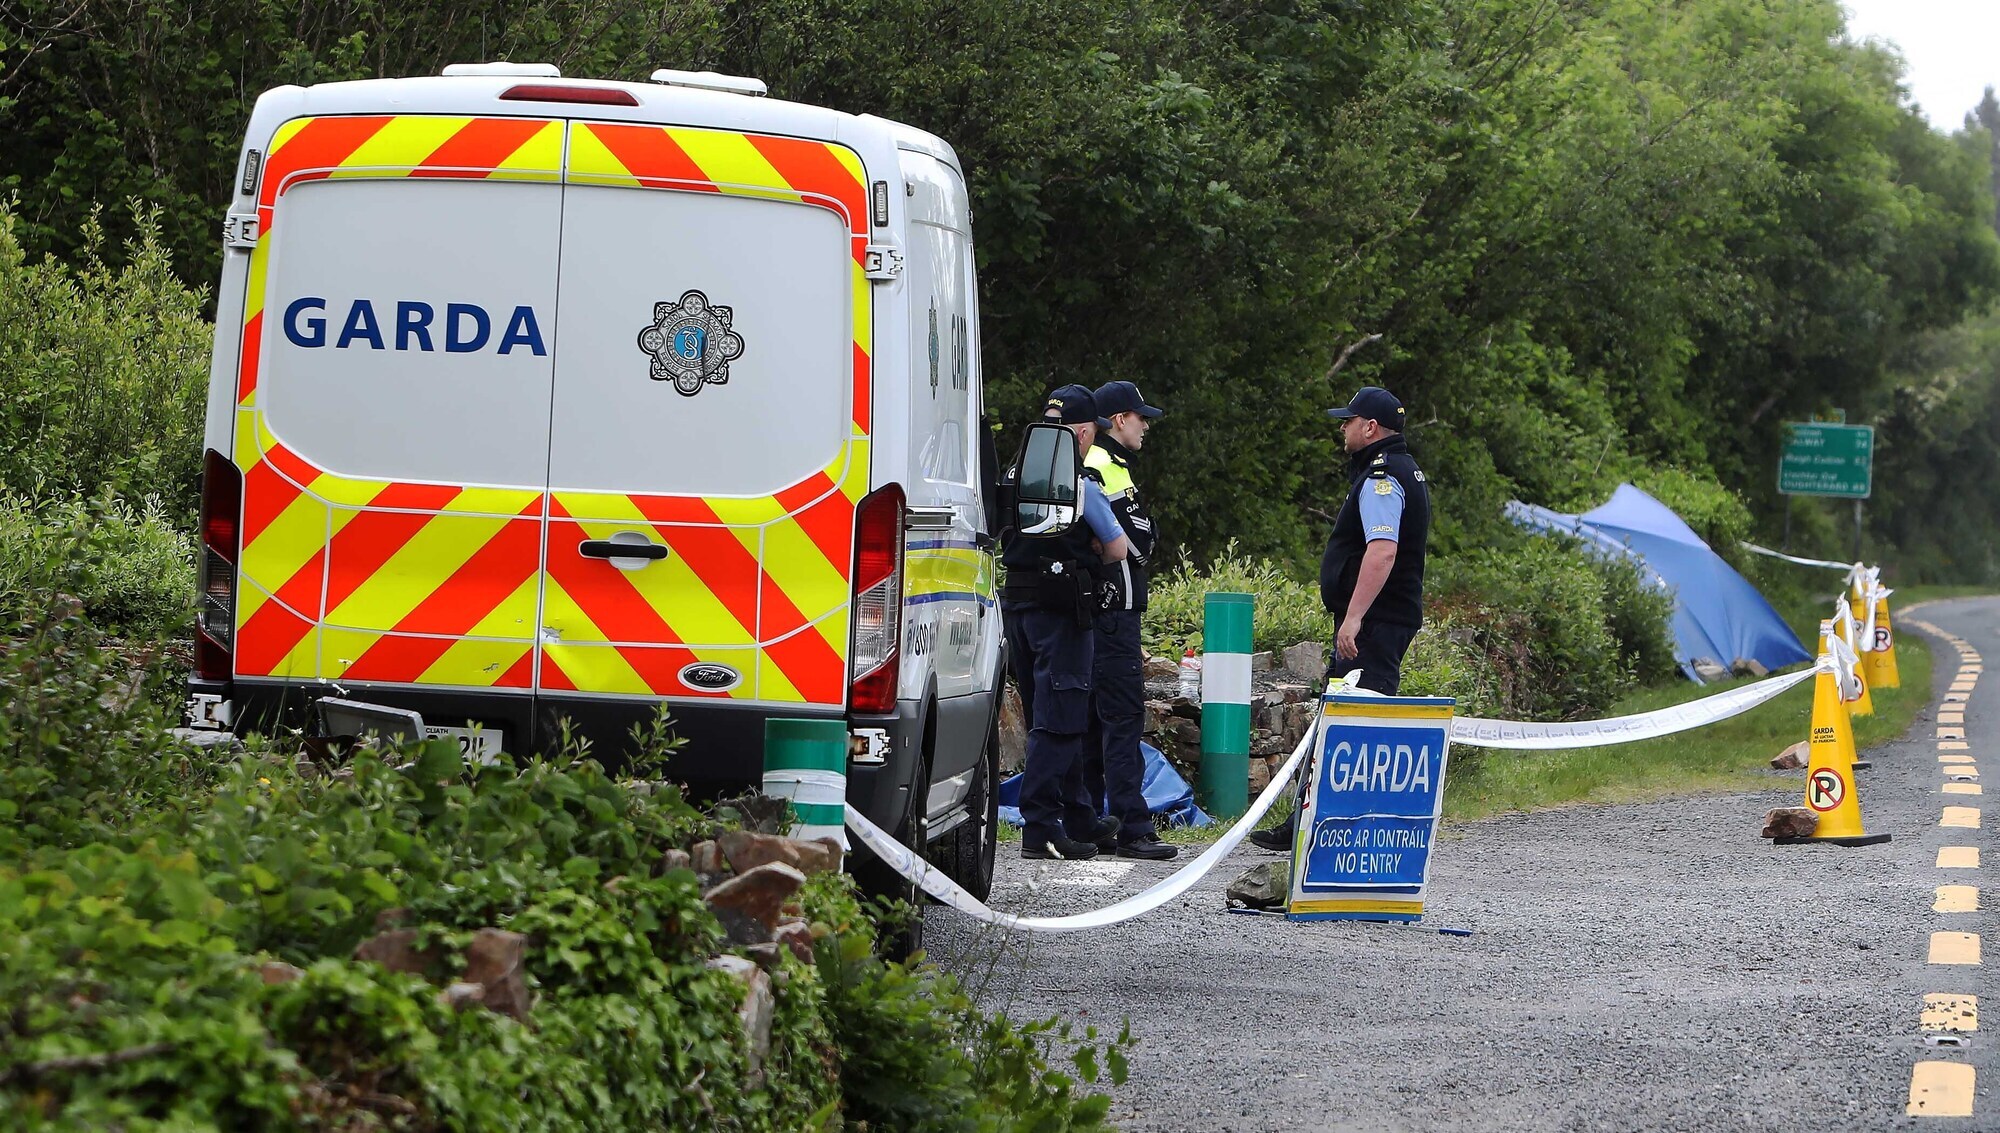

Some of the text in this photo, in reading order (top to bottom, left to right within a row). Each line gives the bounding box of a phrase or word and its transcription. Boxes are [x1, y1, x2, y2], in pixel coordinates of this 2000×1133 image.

[283, 297, 548, 357] GARDA
[695, 669, 725, 682] Ford
[425, 727, 449, 735] CLIATH
[1813, 727, 1835, 735] GARDA
[1329, 741, 1430, 793] GARDA
[1320, 825, 1426, 849] COSC AR IONTRÁIL
[1334, 852, 1402, 874] NO ENTRY
